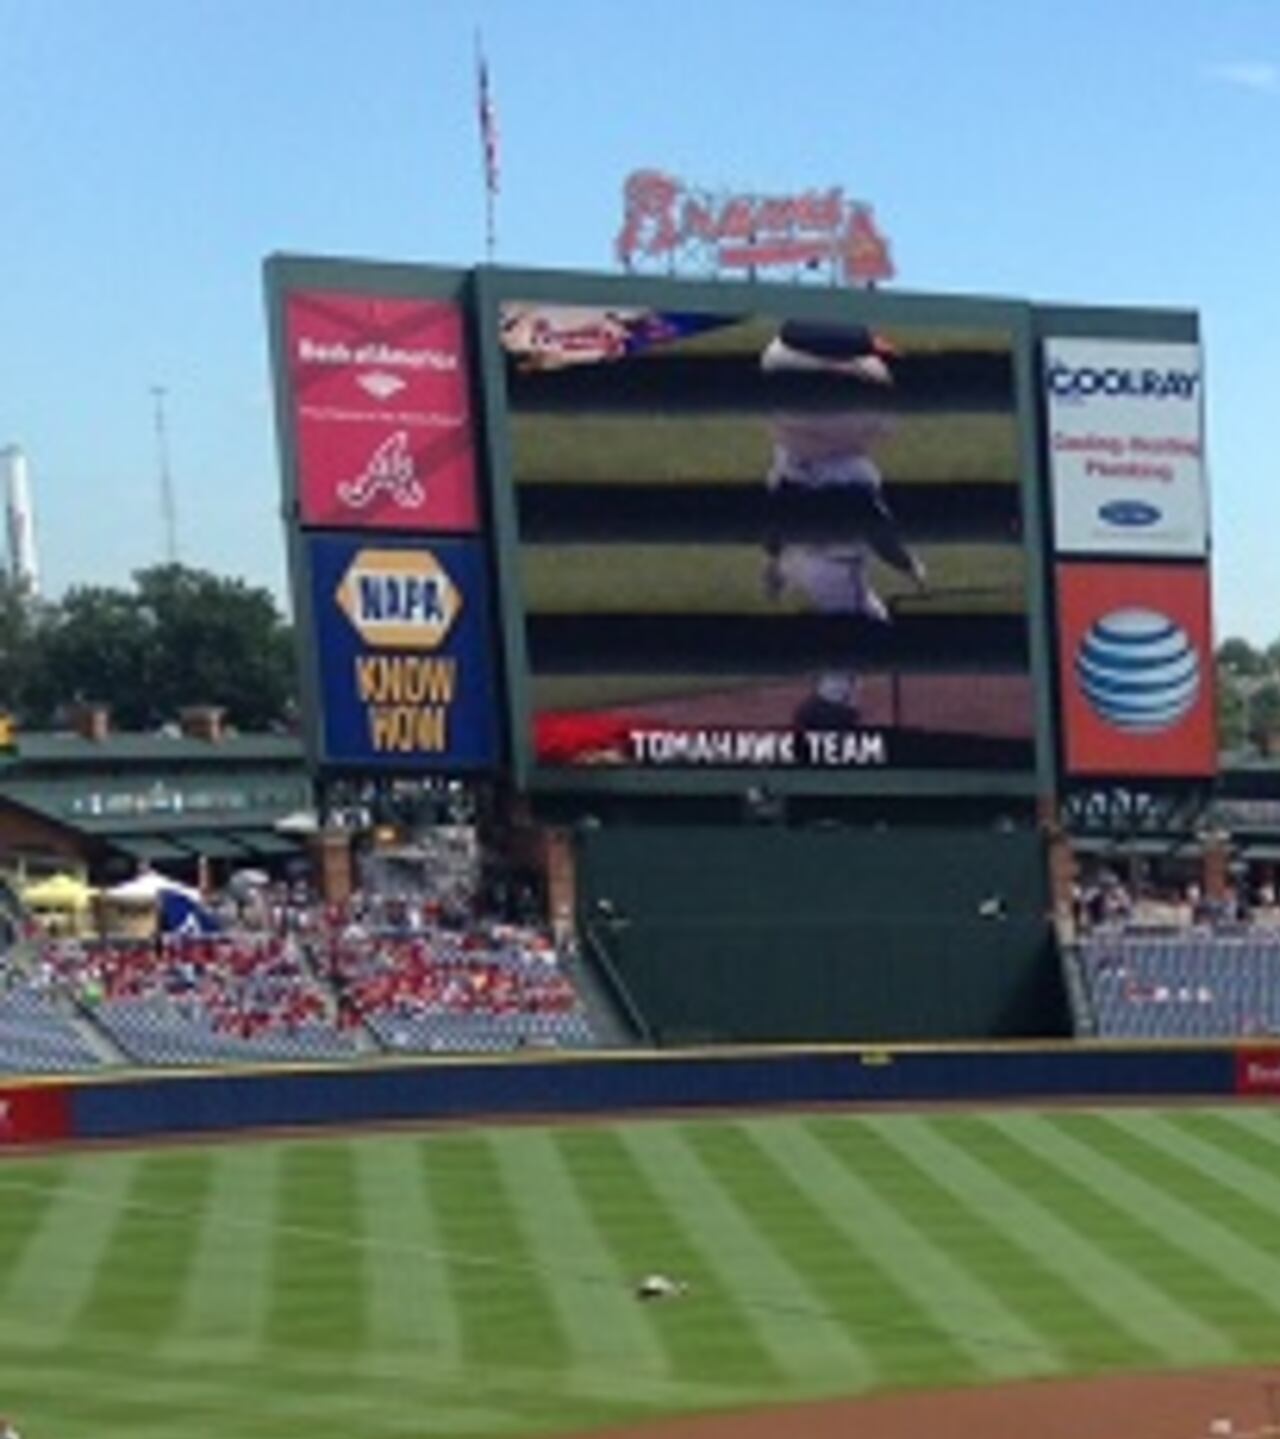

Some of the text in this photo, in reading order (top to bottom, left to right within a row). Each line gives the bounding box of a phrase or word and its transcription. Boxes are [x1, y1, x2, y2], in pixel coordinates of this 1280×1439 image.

[1048, 362, 1199, 400] COOLRAY
[359, 574, 445, 622] NAPA
[356, 655, 456, 703] KNOW
[369, 705, 445, 752] HOW
[629, 729, 886, 765] TOMAHAWK TEAM
